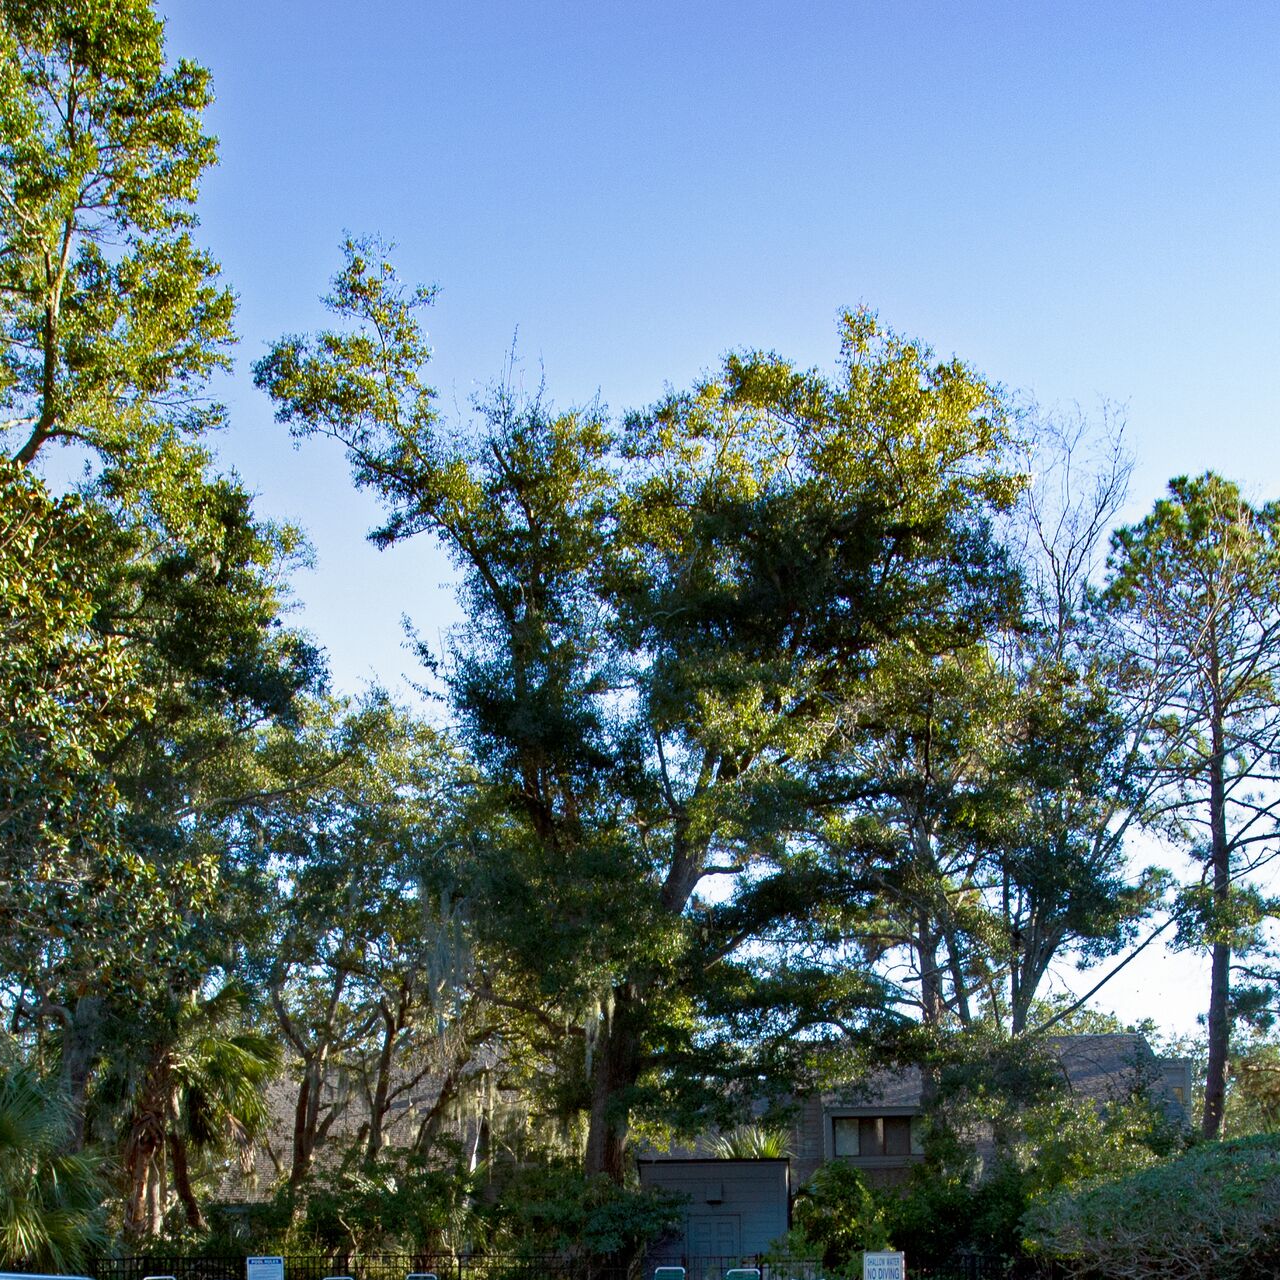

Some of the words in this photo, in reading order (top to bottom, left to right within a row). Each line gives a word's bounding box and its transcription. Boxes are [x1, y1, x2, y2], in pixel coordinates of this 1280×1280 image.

[867, 1257, 885, 1266] SHALLOW
[886, 1257, 900, 1266] WATER
[867, 1268, 877, 1279] NO
[878, 1267, 900, 1279] DIVING
